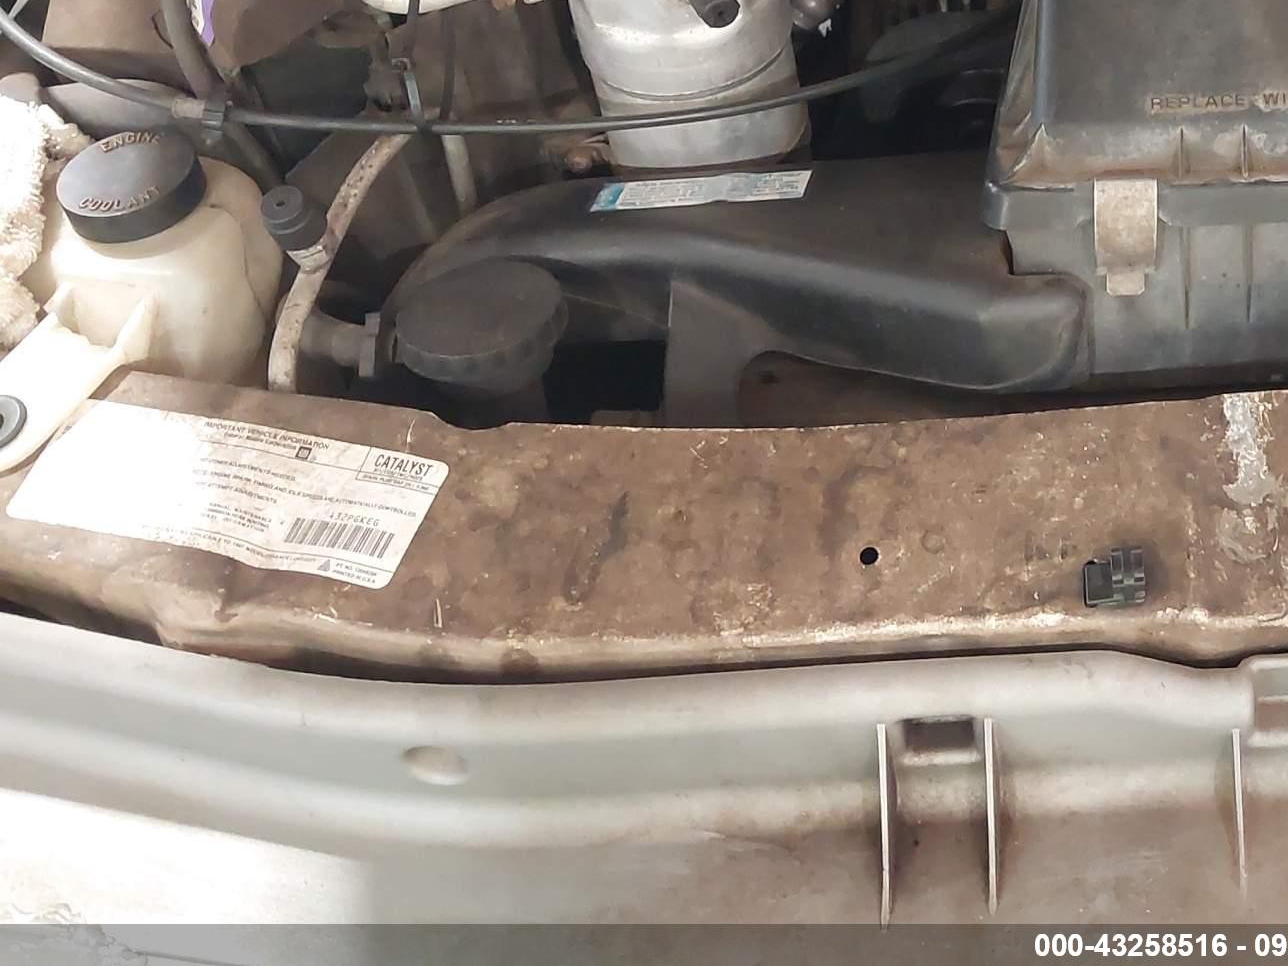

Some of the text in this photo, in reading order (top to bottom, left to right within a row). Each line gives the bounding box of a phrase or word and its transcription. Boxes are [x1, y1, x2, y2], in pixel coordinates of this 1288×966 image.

[1150, 92, 1246, 111] REPLACE
[79, 185, 160, 211] COOLANT
[374, 453, 434, 478] CATALYST
